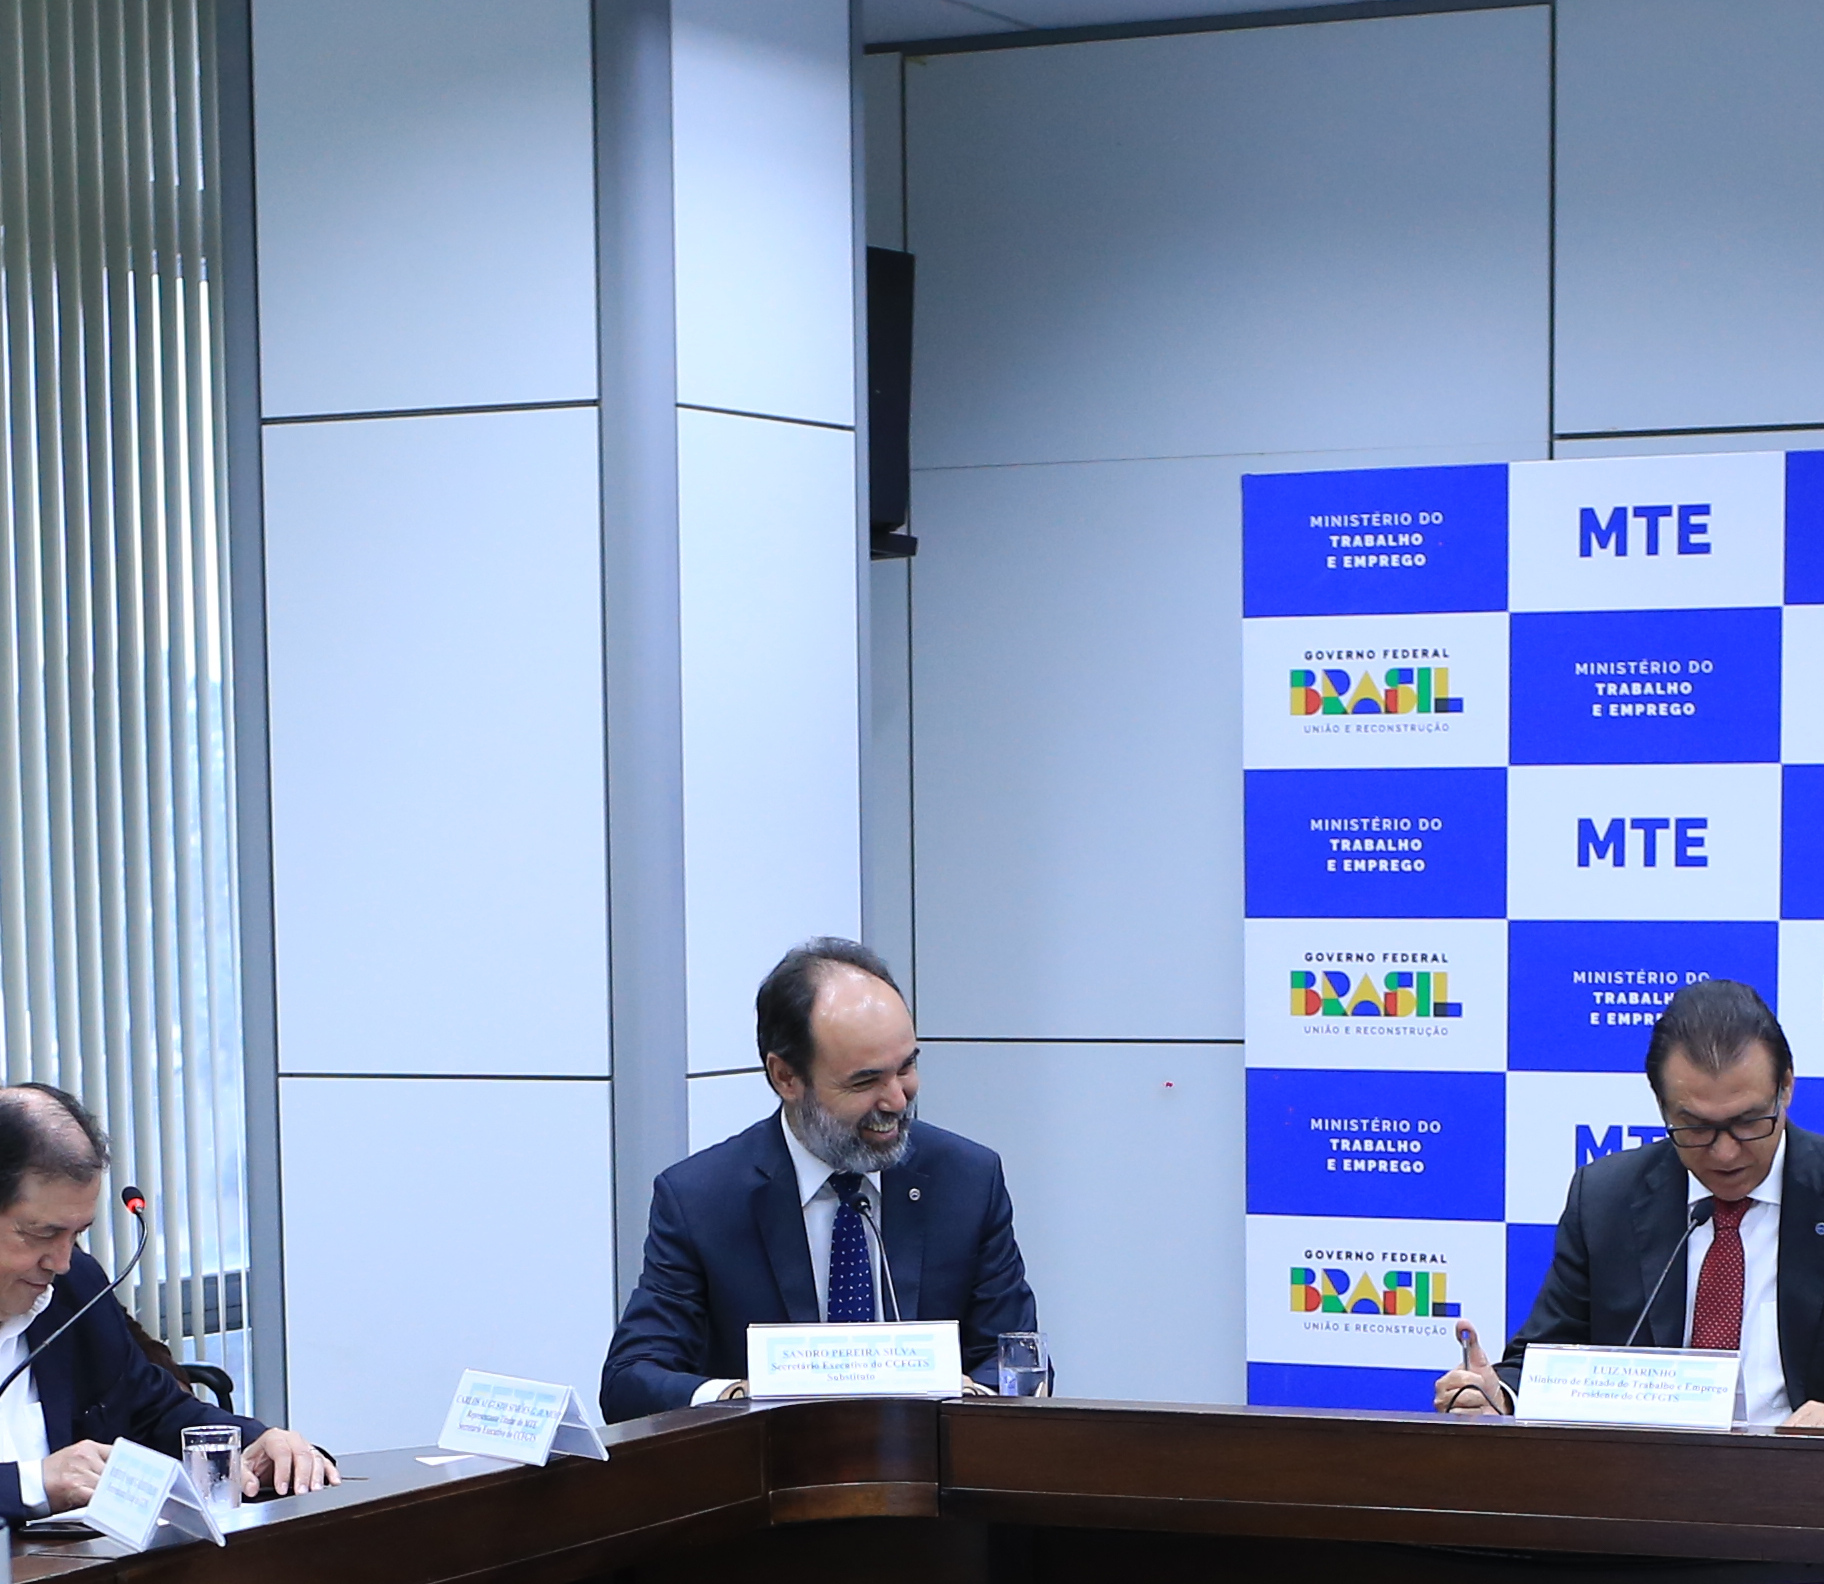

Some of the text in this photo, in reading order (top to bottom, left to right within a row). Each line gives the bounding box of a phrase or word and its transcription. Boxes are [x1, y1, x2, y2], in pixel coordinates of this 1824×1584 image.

[1310, 511, 1442, 527] MINISTÉRIO DO
[1580, 503, 1711, 557] MTE
[1329, 533, 1423, 547] TRABALHO
[1327, 554, 1426, 568] E EMPREGO
[1304, 648, 1449, 660] GOVERNO FEDERAL
[1576, 659, 1713, 675] MINISTÉRIO DO
[1289, 666, 1464, 715] BRASIL
[1595, 682, 1692, 695] TRABALHO
[1593, 703, 1695, 716] E EMPREGO
[1304, 721, 1449, 733] UNIÃO E RECONSTRUÇÃO
[1311, 816, 1442, 831] MINISTÉRIO DO
[1330, 839, 1422, 851] TRABALHO
[1577, 817, 1708, 867] MTE
[1327, 860, 1425, 871] E EMPREGO
[1305, 952, 1448, 963] GOVERNO FEDERAL
[1290, 970, 1463, 1018] BRASIL
[1304, 1024, 1448, 1036] UNIÃO E RECONSTRUÇÃO
[1311, 1117, 1440, 1133] MINISTÉRIO DO
[1330, 1139, 1421, 1152] TRABALHO
[1327, 1159, 1424, 1172] E EMPREGO
[1304, 1250, 1447, 1263] GOVERNO FEDERAL
[1290, 1267, 1461, 1318] BRASIL
[1304, 1321, 1447, 1336] UNIÃO E RECONSTRUÇÃO
[1593, 1366, 1619, 1376] LUIZ
